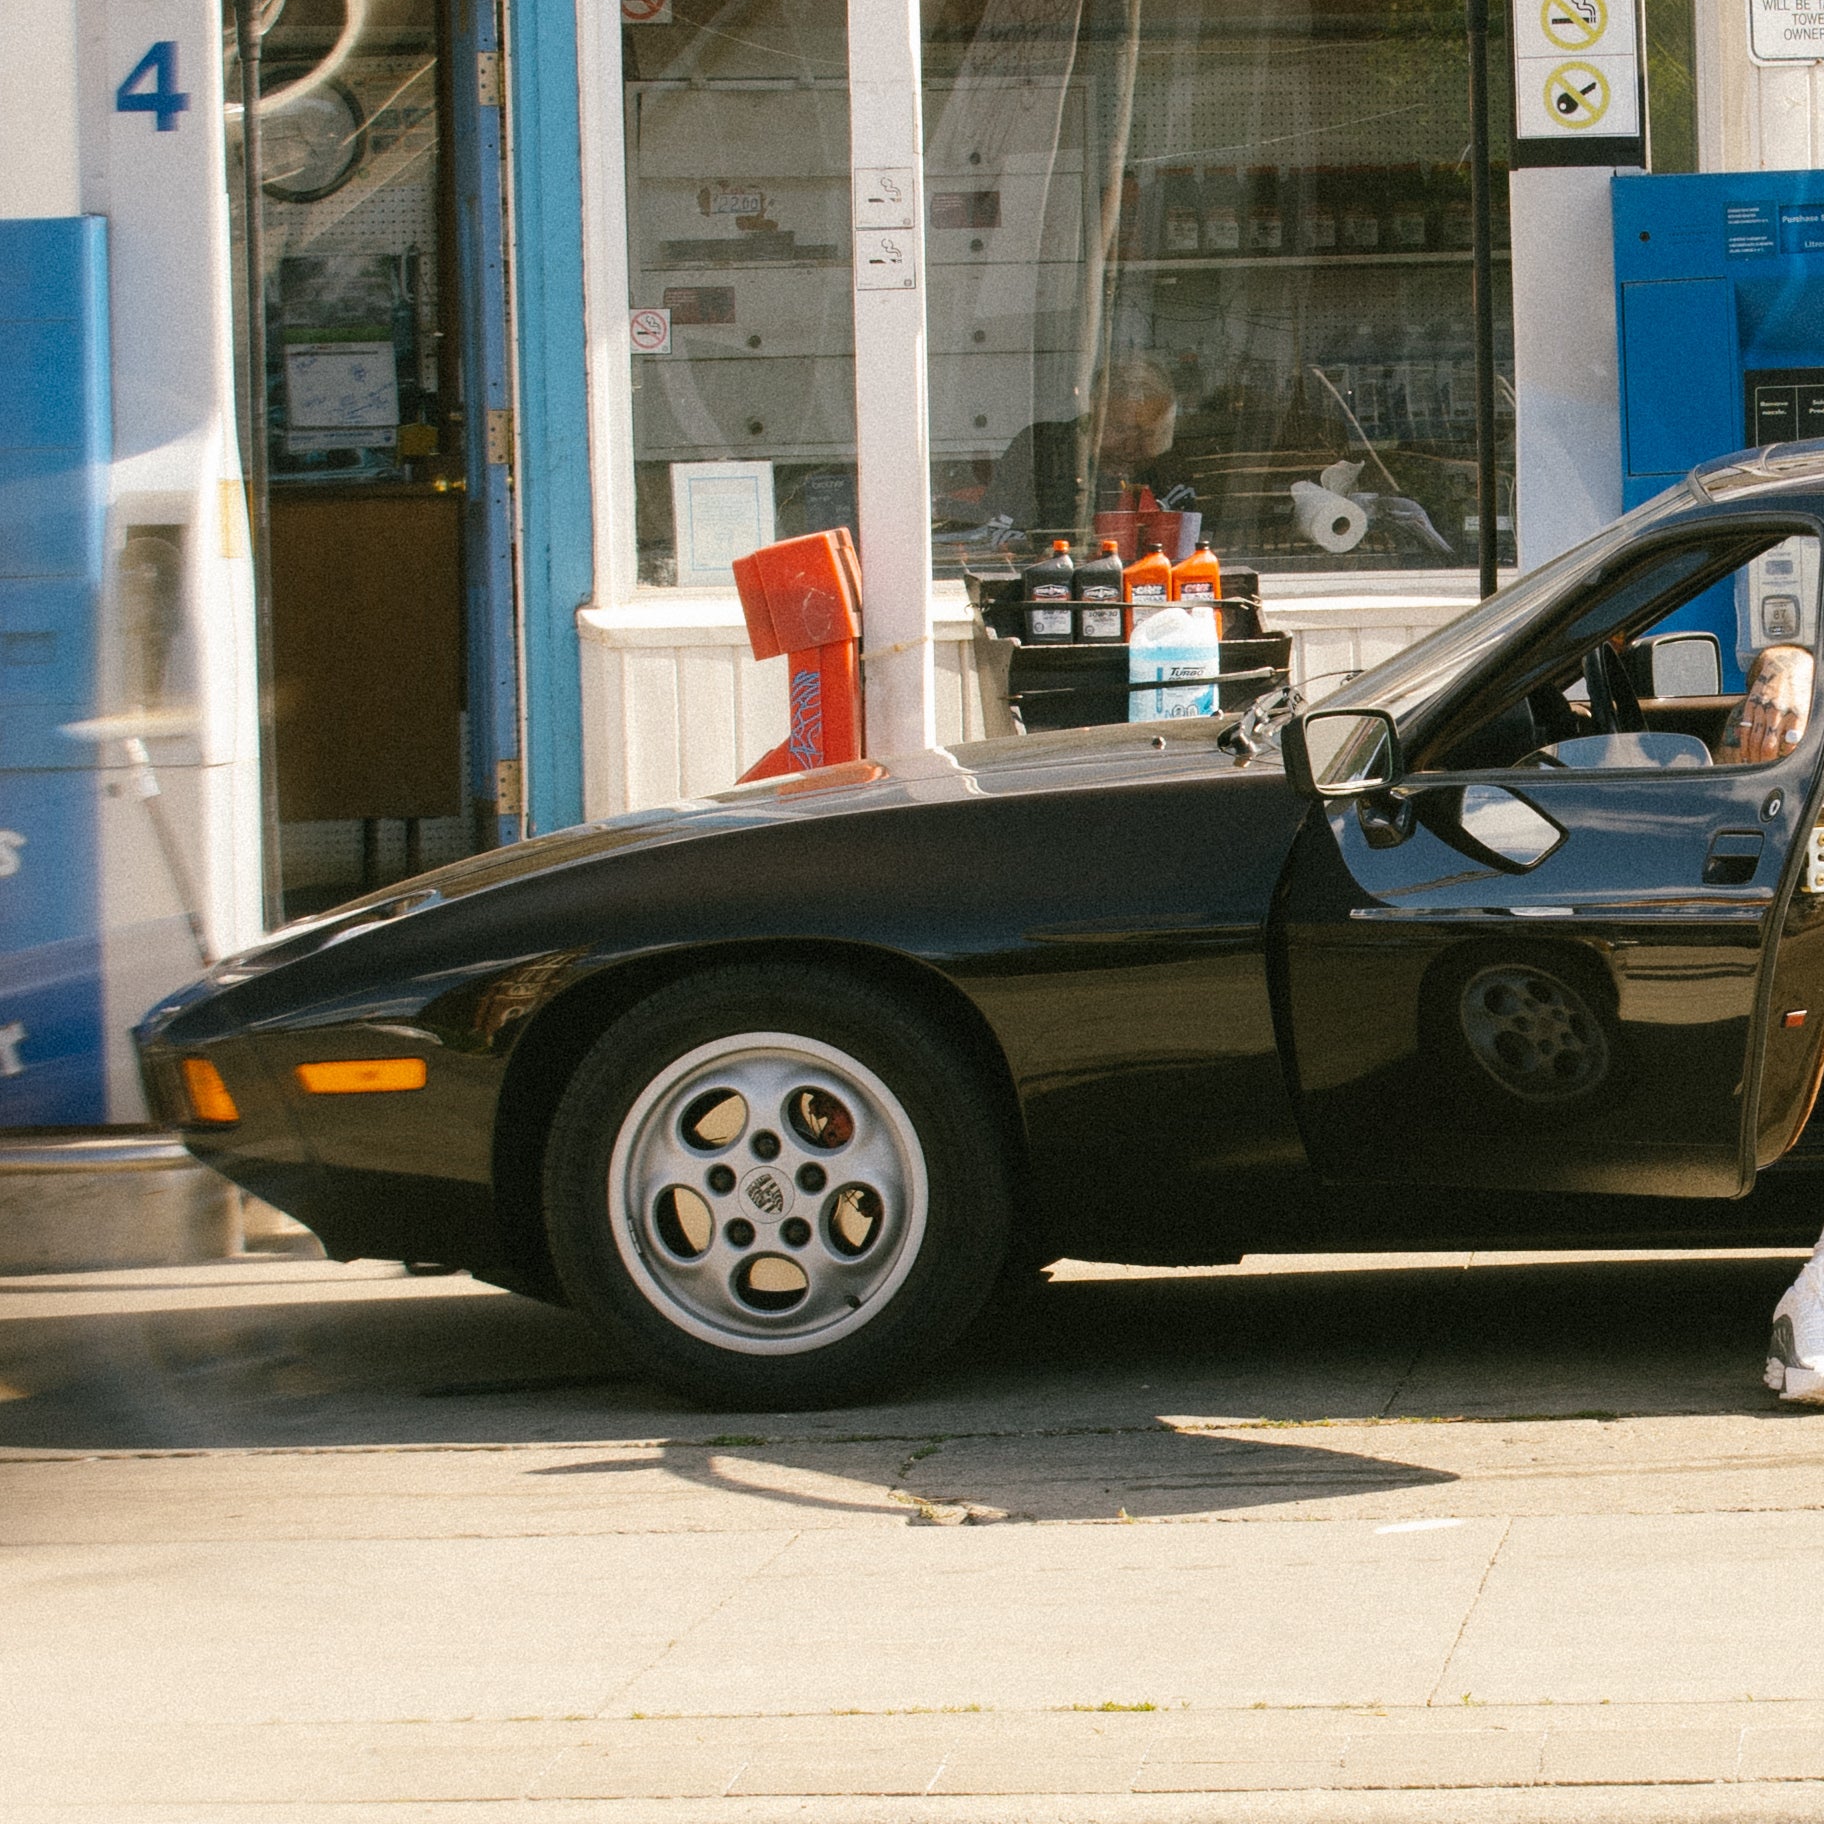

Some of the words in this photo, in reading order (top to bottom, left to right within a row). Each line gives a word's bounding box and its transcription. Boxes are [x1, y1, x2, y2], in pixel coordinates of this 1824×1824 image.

[1763, 0, 1790, 11] WILL
[116, 40, 190, 132] 4
[1782, 215, 1818, 223] Purchase
[1773, 610, 1787, 620] 87
